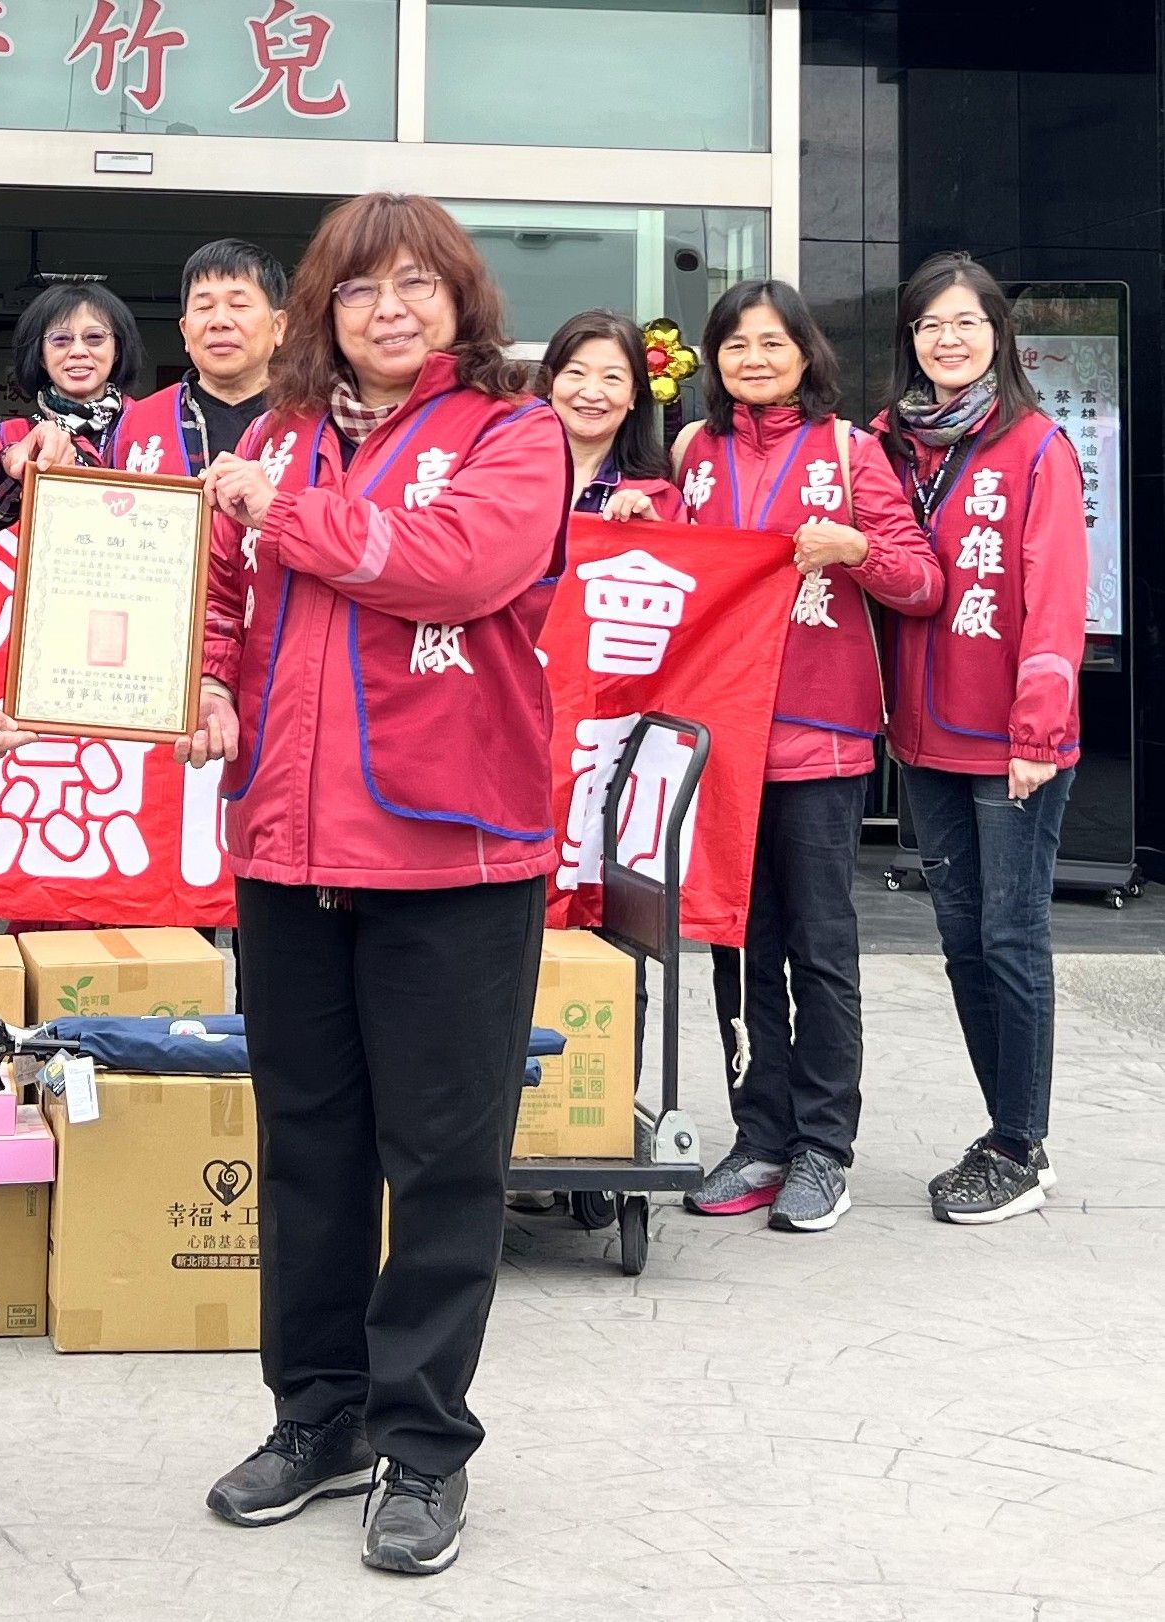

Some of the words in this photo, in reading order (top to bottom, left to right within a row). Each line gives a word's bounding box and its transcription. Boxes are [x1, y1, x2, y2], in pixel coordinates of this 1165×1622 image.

[403, 446, 475, 676] 高廠
[951, 467, 1008, 641] 高雄廠
